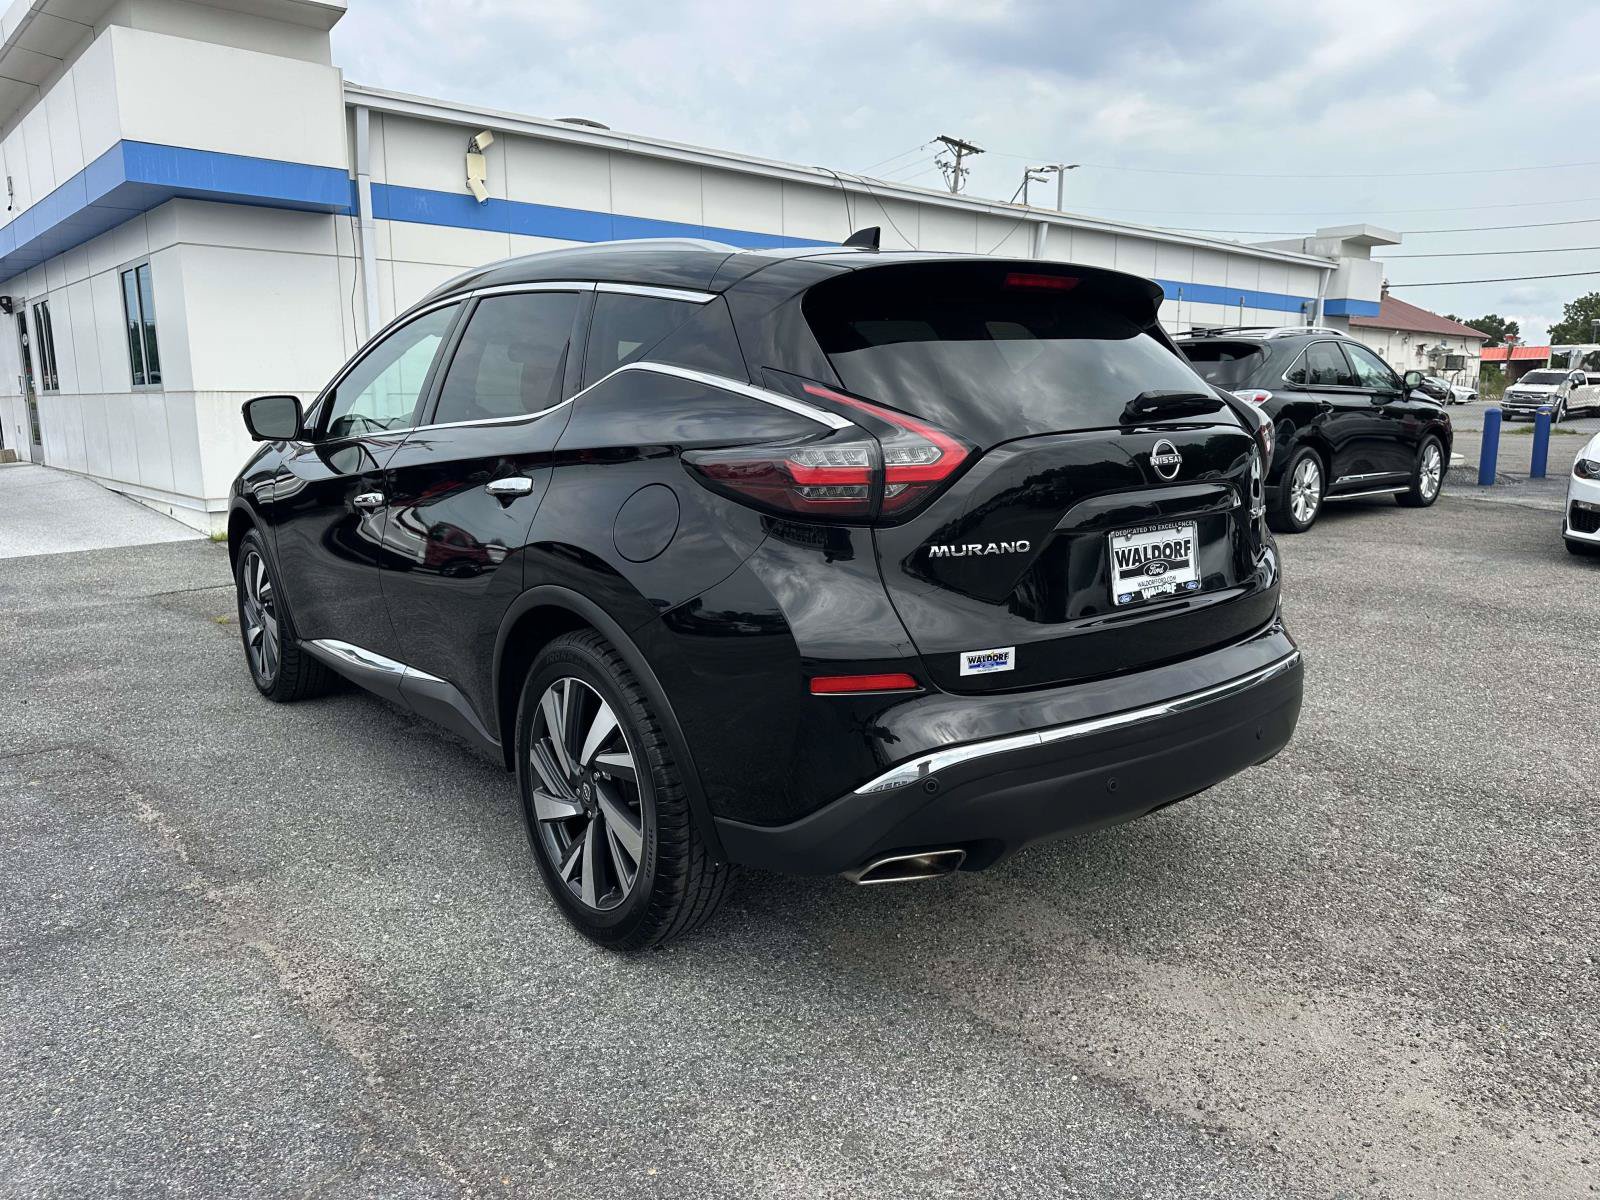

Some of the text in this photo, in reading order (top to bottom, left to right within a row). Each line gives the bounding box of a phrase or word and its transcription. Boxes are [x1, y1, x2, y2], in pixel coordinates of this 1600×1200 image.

[1151, 456, 1183, 466] NISSAN
[1115, 527, 1148, 537] DEDICATED
[1157, 521, 1193, 531] EXCELLENCE
[928, 540, 1031, 558] MURANO
[1114, 539, 1191, 569] WALDORF
[1148, 563, 1164, 576] Ford
[1141, 583, 1177, 599] WALDORF
[967, 653, 1009, 664] WALDORF
